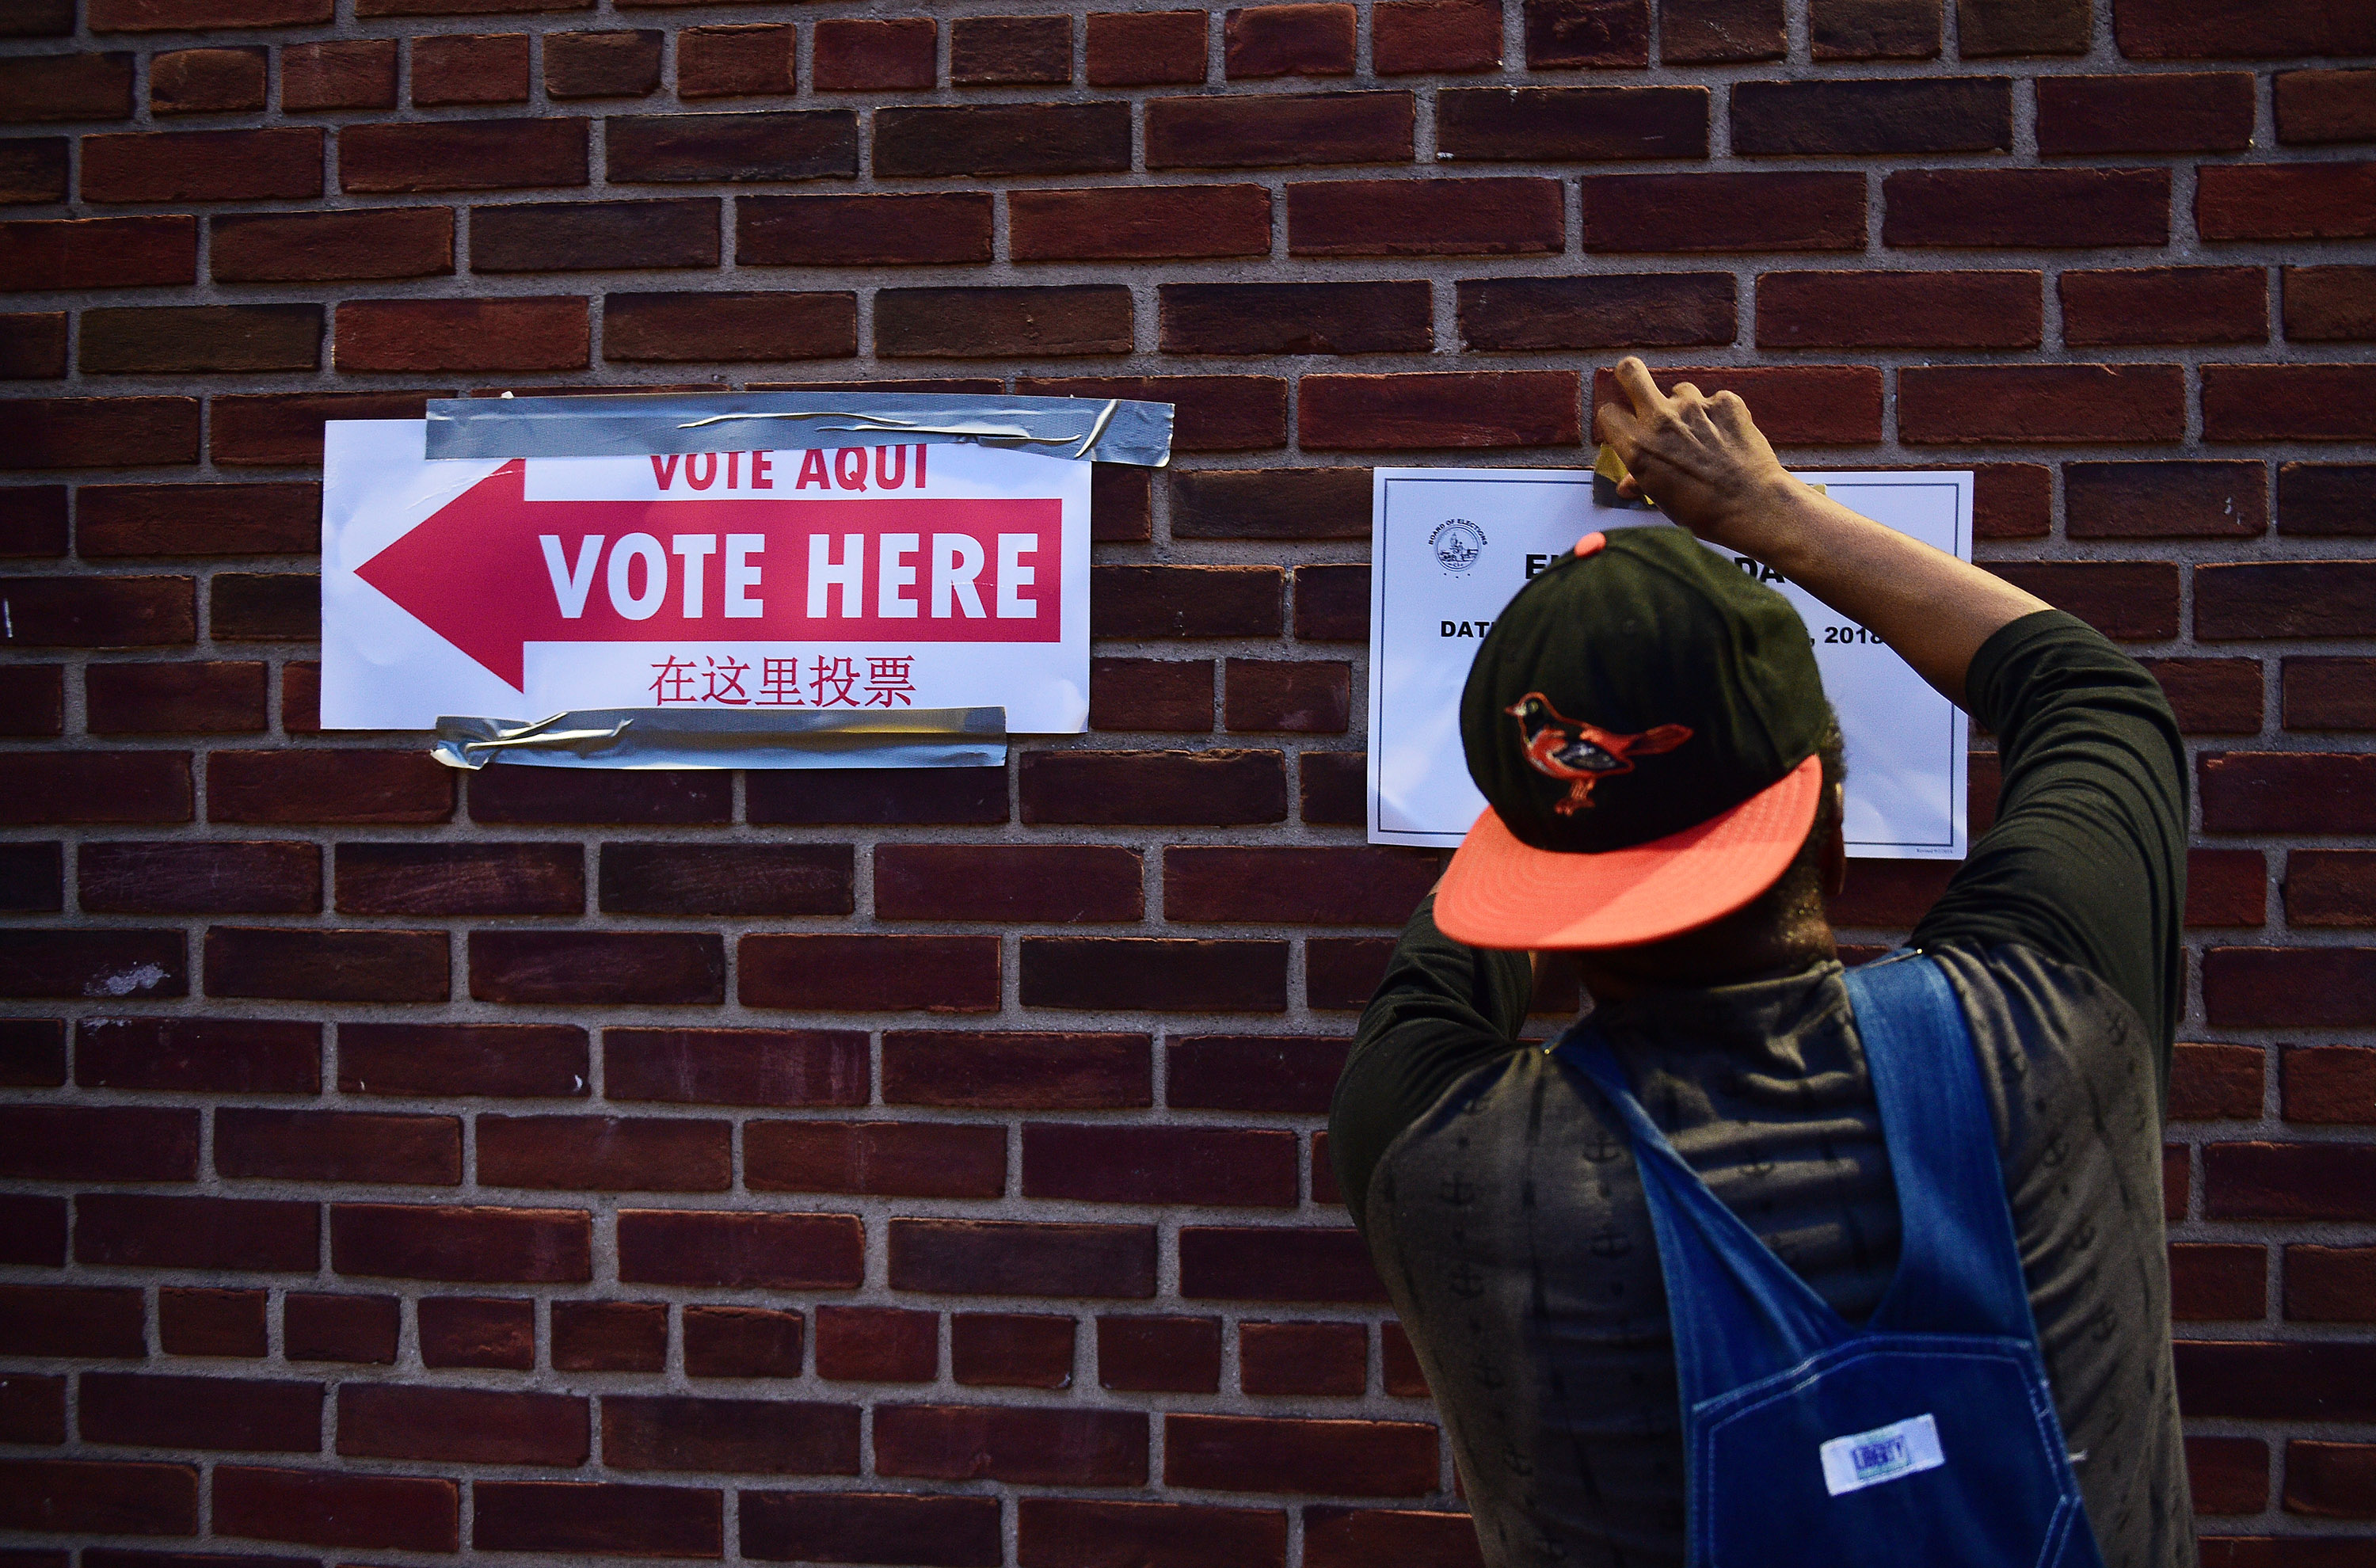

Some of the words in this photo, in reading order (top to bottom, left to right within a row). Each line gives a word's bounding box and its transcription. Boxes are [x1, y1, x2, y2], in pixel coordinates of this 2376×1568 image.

[649, 450, 773, 491] VOTE
[795, 443, 927, 493] AQUI
[1428, 523, 1445, 546] BOARD
[1456, 519, 1488, 546] ELECTIONS
[539, 531, 765, 621] VOTE
[807, 531, 1038, 621] HERE
[1441, 620, 1495, 638] DAT
[649, 653, 916, 709] 在这里投票
